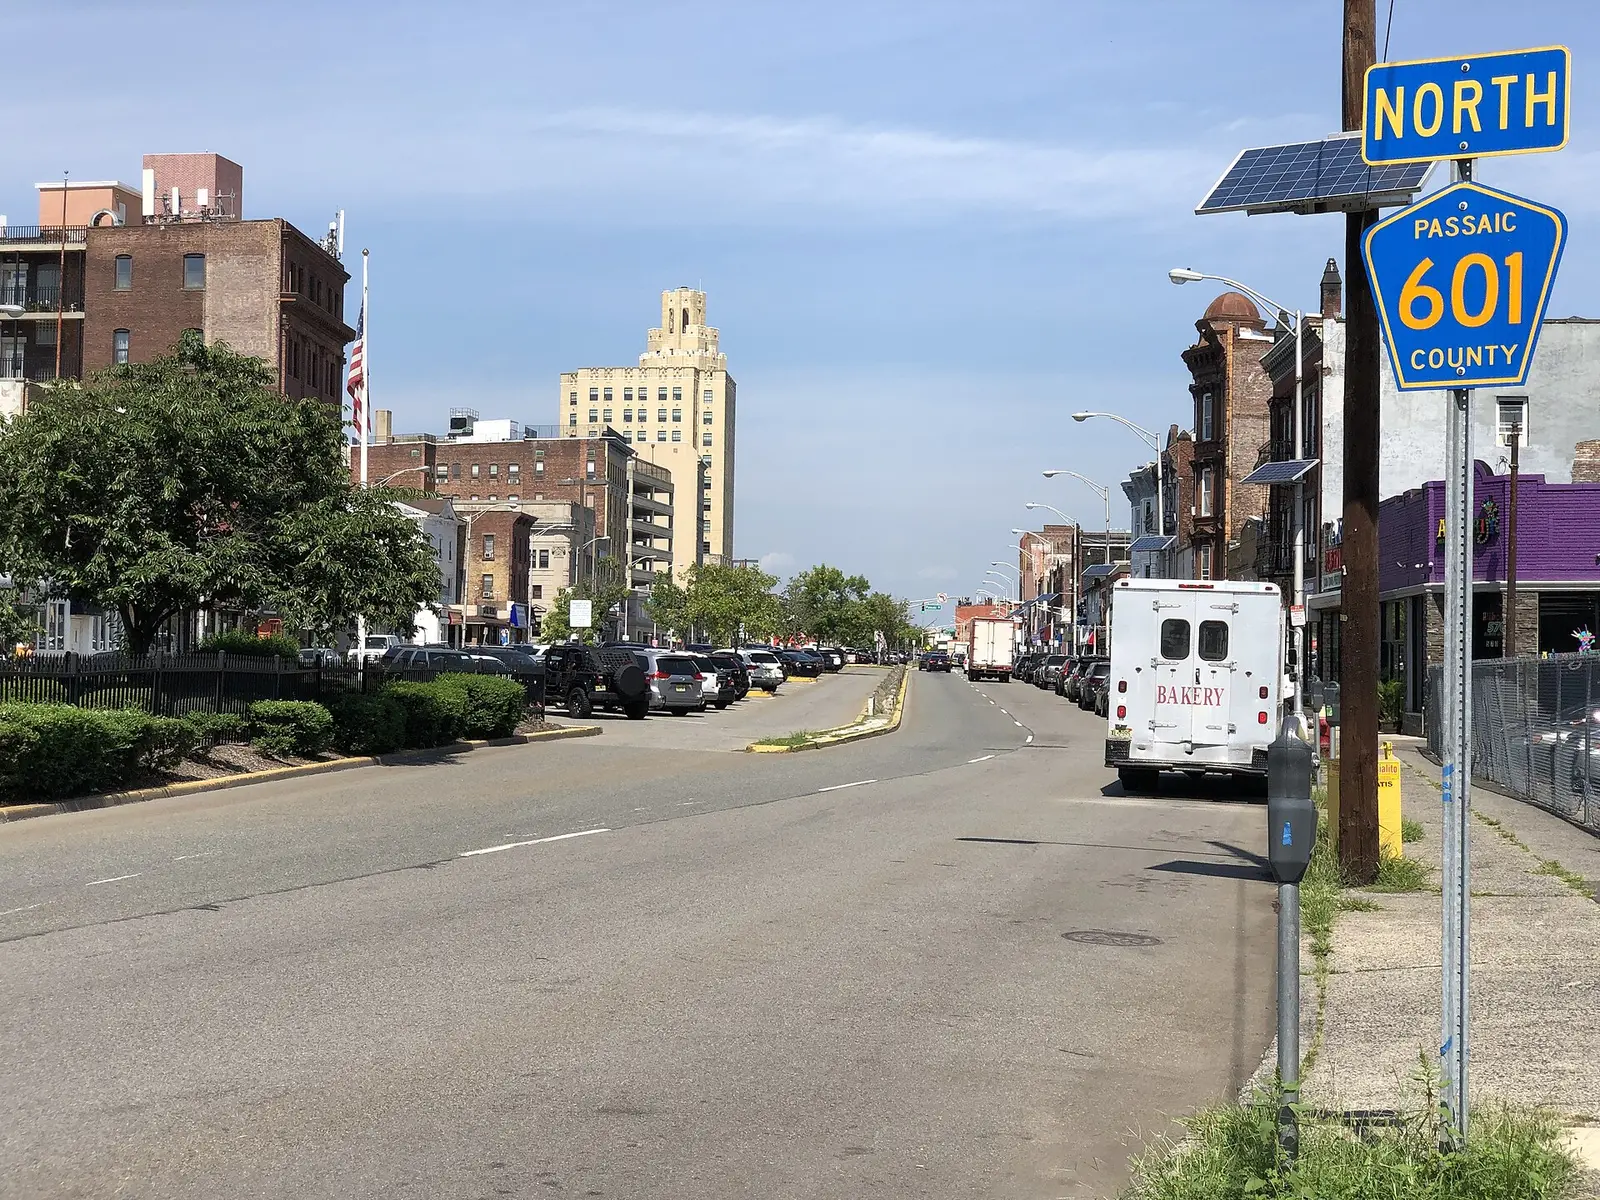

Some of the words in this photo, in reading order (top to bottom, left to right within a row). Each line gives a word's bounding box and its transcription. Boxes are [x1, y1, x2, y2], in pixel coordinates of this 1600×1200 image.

[1374, 71, 1556, 140] NORTH
[1414, 212, 1517, 239] PASSAIC
[1398, 252, 1523, 330] 601
[1410, 344, 1519, 370] COUNTY
[1156, 685, 1225, 706] BAKERY
[1379, 764, 1397, 773] ialito
